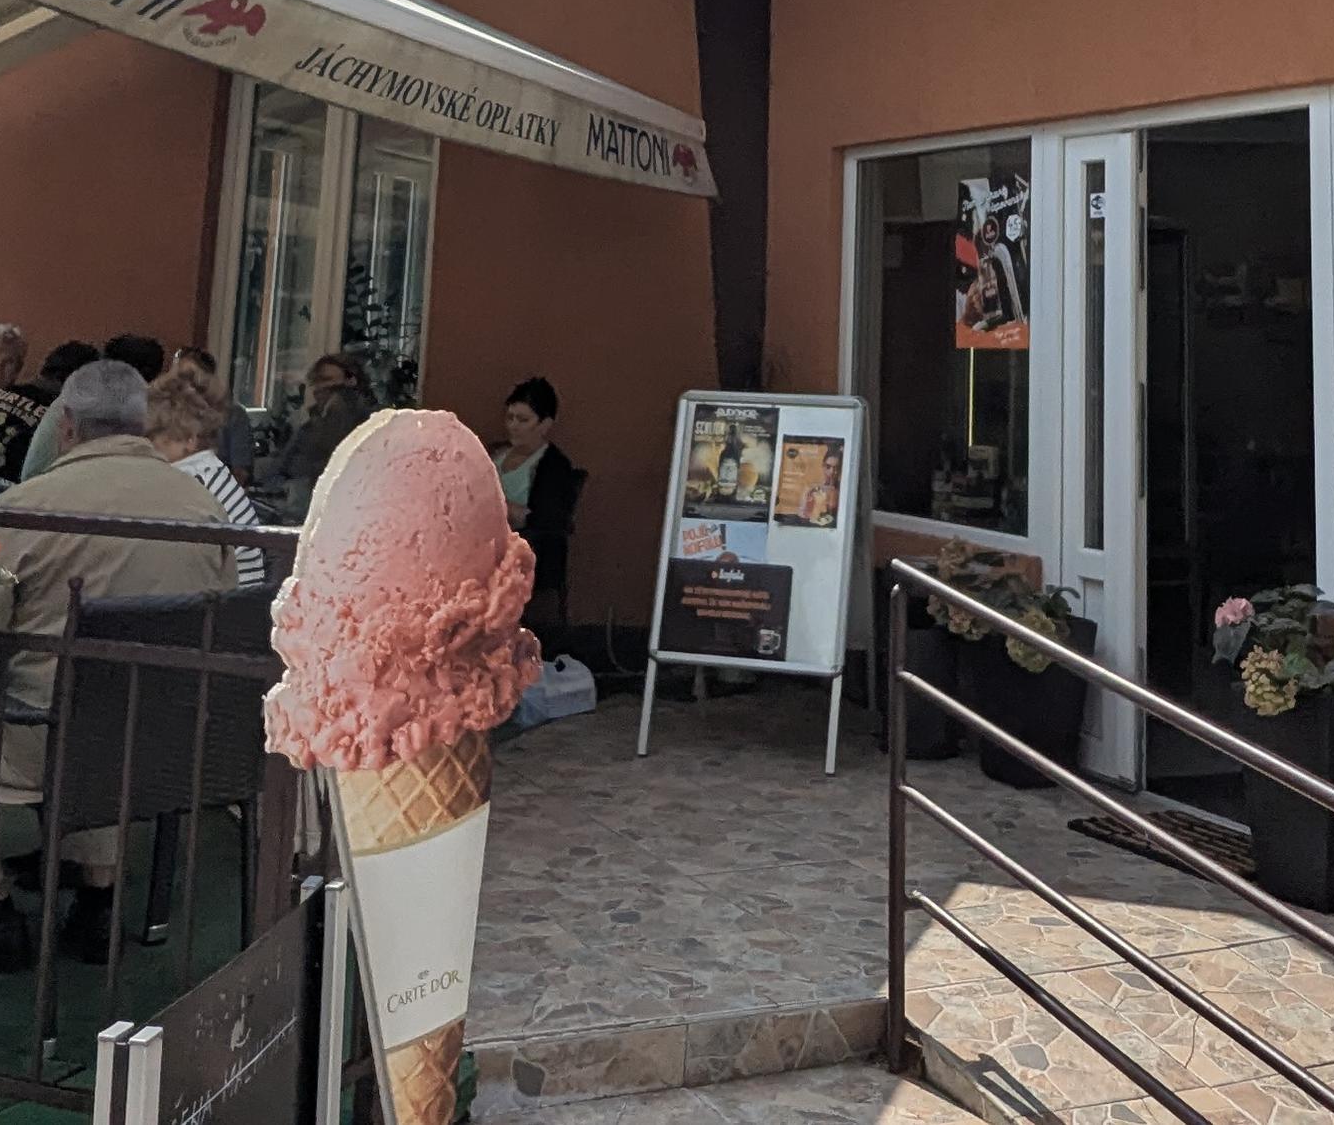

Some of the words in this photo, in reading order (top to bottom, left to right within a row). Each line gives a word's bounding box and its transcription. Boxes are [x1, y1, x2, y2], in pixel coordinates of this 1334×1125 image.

[295, 43, 477, 123] JÁCHYMOVSKÉ
[475, 100, 562, 147] OPLATKY
[586, 113, 671, 176] MATTONI
[387, 983, 427, 1013] CARTE
